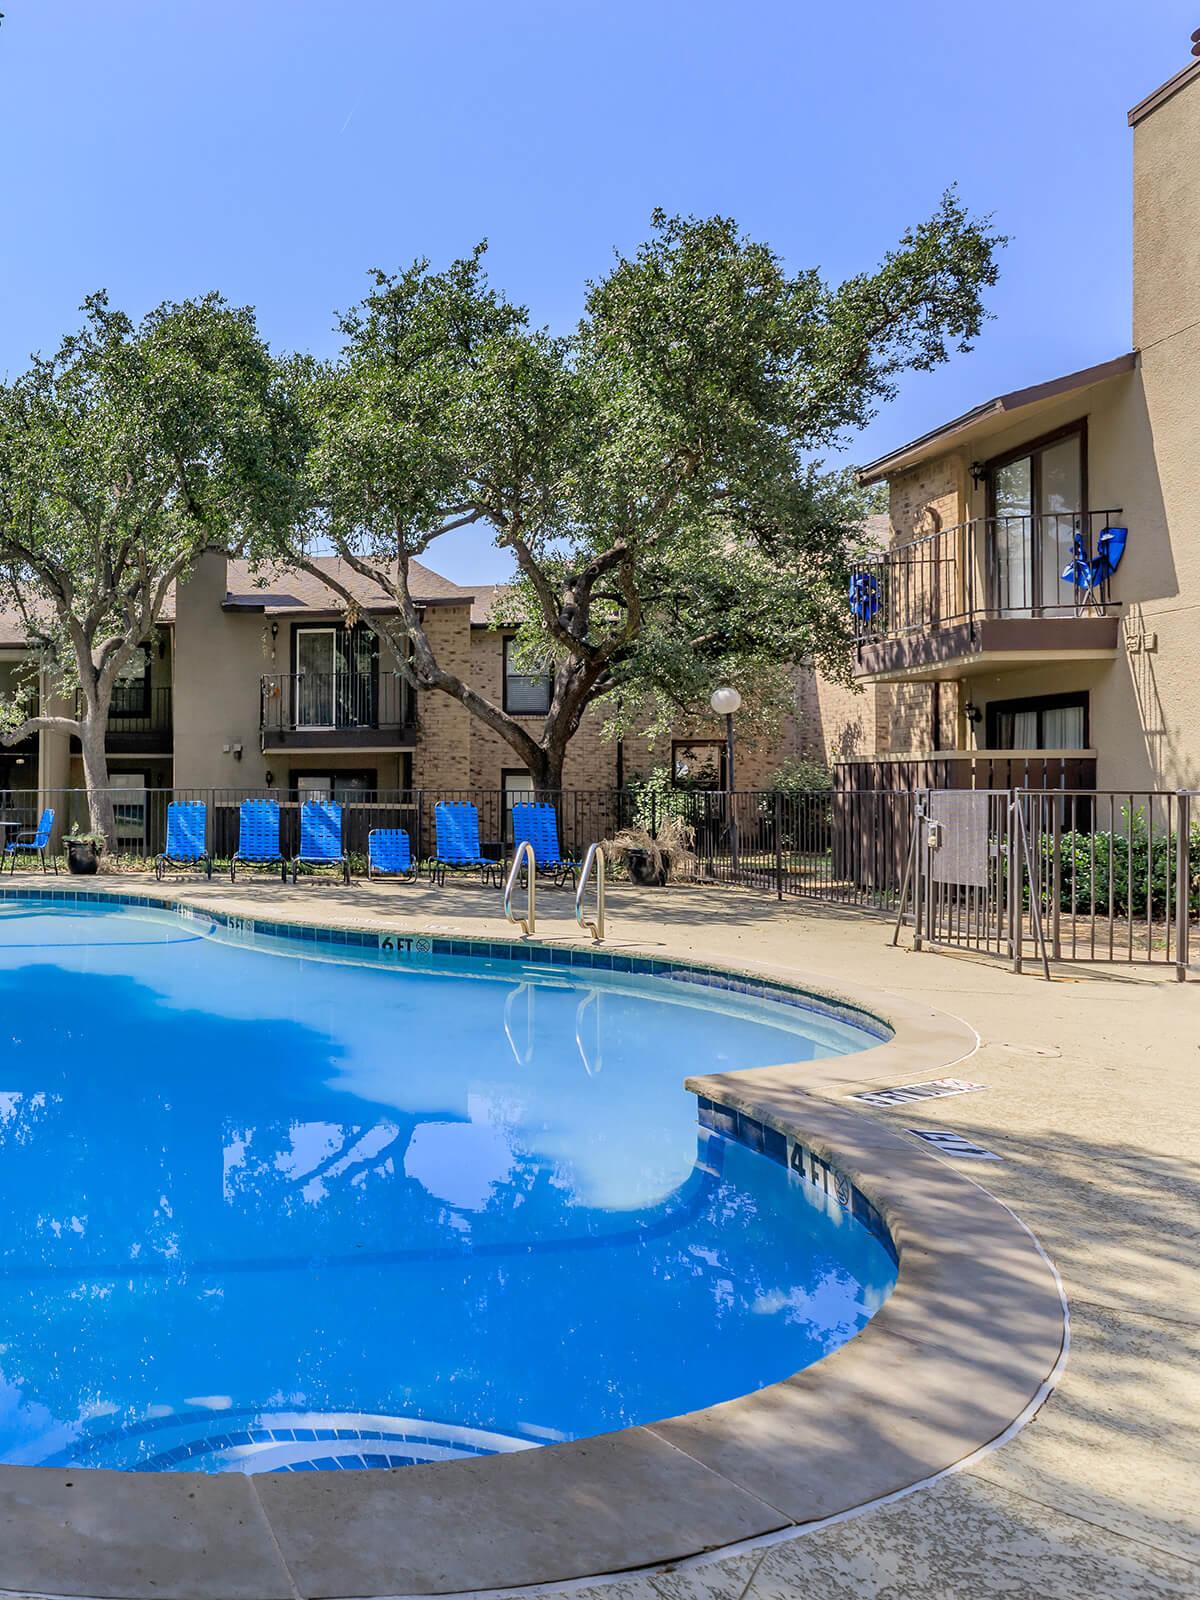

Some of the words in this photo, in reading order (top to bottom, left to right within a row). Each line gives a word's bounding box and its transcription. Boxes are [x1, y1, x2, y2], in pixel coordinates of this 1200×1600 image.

[382, 936, 394, 951] 6
[398, 938, 414, 952] FT
[791, 1143, 806, 1178] 4
[810, 1152, 831, 1195] FT
